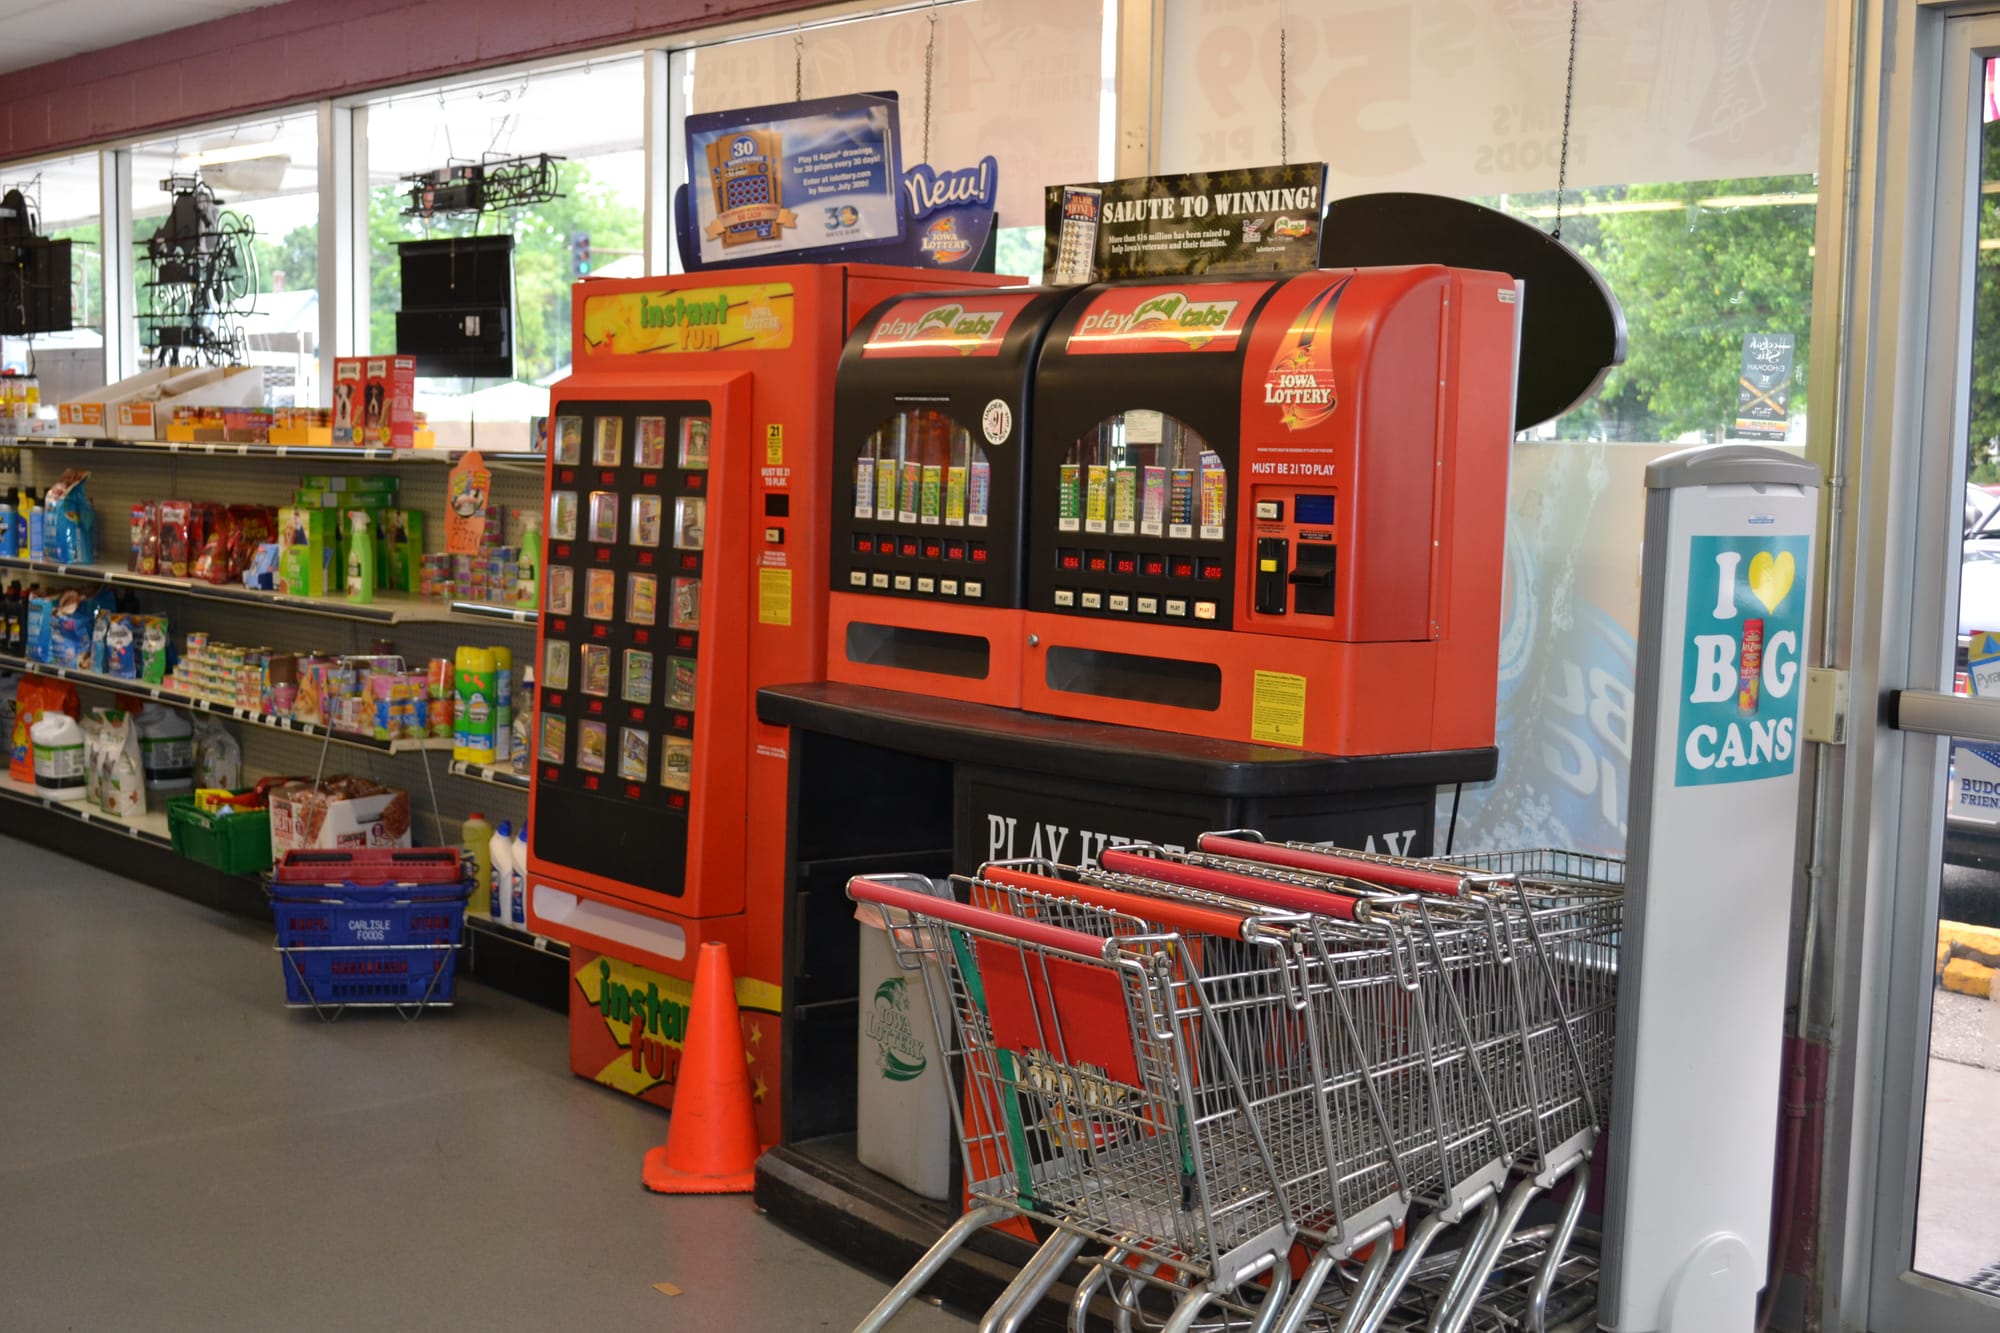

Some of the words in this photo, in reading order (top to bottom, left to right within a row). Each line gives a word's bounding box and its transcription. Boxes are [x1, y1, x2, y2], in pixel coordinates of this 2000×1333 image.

[733, 140, 754, 158] 30
[904, 162, 986, 215] New!
[1102, 197, 1175, 225] SALUTE
[1181, 193, 1209, 219] TO
[1214, 186, 1318, 217] WINNING!
[921, 237, 967, 251] LOTTERY
[931, 232, 958, 241] IOWA
[1142, 241, 1168, 252] veterans
[1169, 240, 1182, 250] and
[1183, 239, 1199, 249] their
[1149, 231, 1173, 241] million
[1174, 230, 1185, 240] has
[1186, 229, 1201, 239] been
[1203, 227, 1223, 238] raised
[1223, 228, 1231, 237] to
[640, 294, 728, 328] instant
[874, 317, 920, 341] play
[917, 306, 961, 330] pull
[954, 314, 994, 335] tabs
[1079, 309, 1133, 336] play
[1133, 295, 1182, 323] pull
[1178, 303, 1227, 328] tabs
[680, 317, 720, 350] fun
[1263, 382, 1332, 405] LOTTERY
[1279, 373, 1318, 389] IOWA
[770, 425, 780, 437] 21
[1252, 462, 1275, 474] MUST
[1277, 463, 1288, 475] BE
[1290, 463, 1299, 475] 21
[1300, 463, 1312, 475] TO
[1313, 464, 1335, 476] PLAY
[1712, 551, 1742, 620] I
[1685, 716, 1794, 770] CANS
[988, 813, 1069, 877] PLAY
[348, 919, 391, 931] CARLISLE
[356, 930, 385, 941] FOODS
[600, 959, 692, 1044] insta
[865, 1011, 925, 1060] LOTTERY
[880, 1008, 912, 1036] IOWA
[630, 1015, 683, 1085] fun
